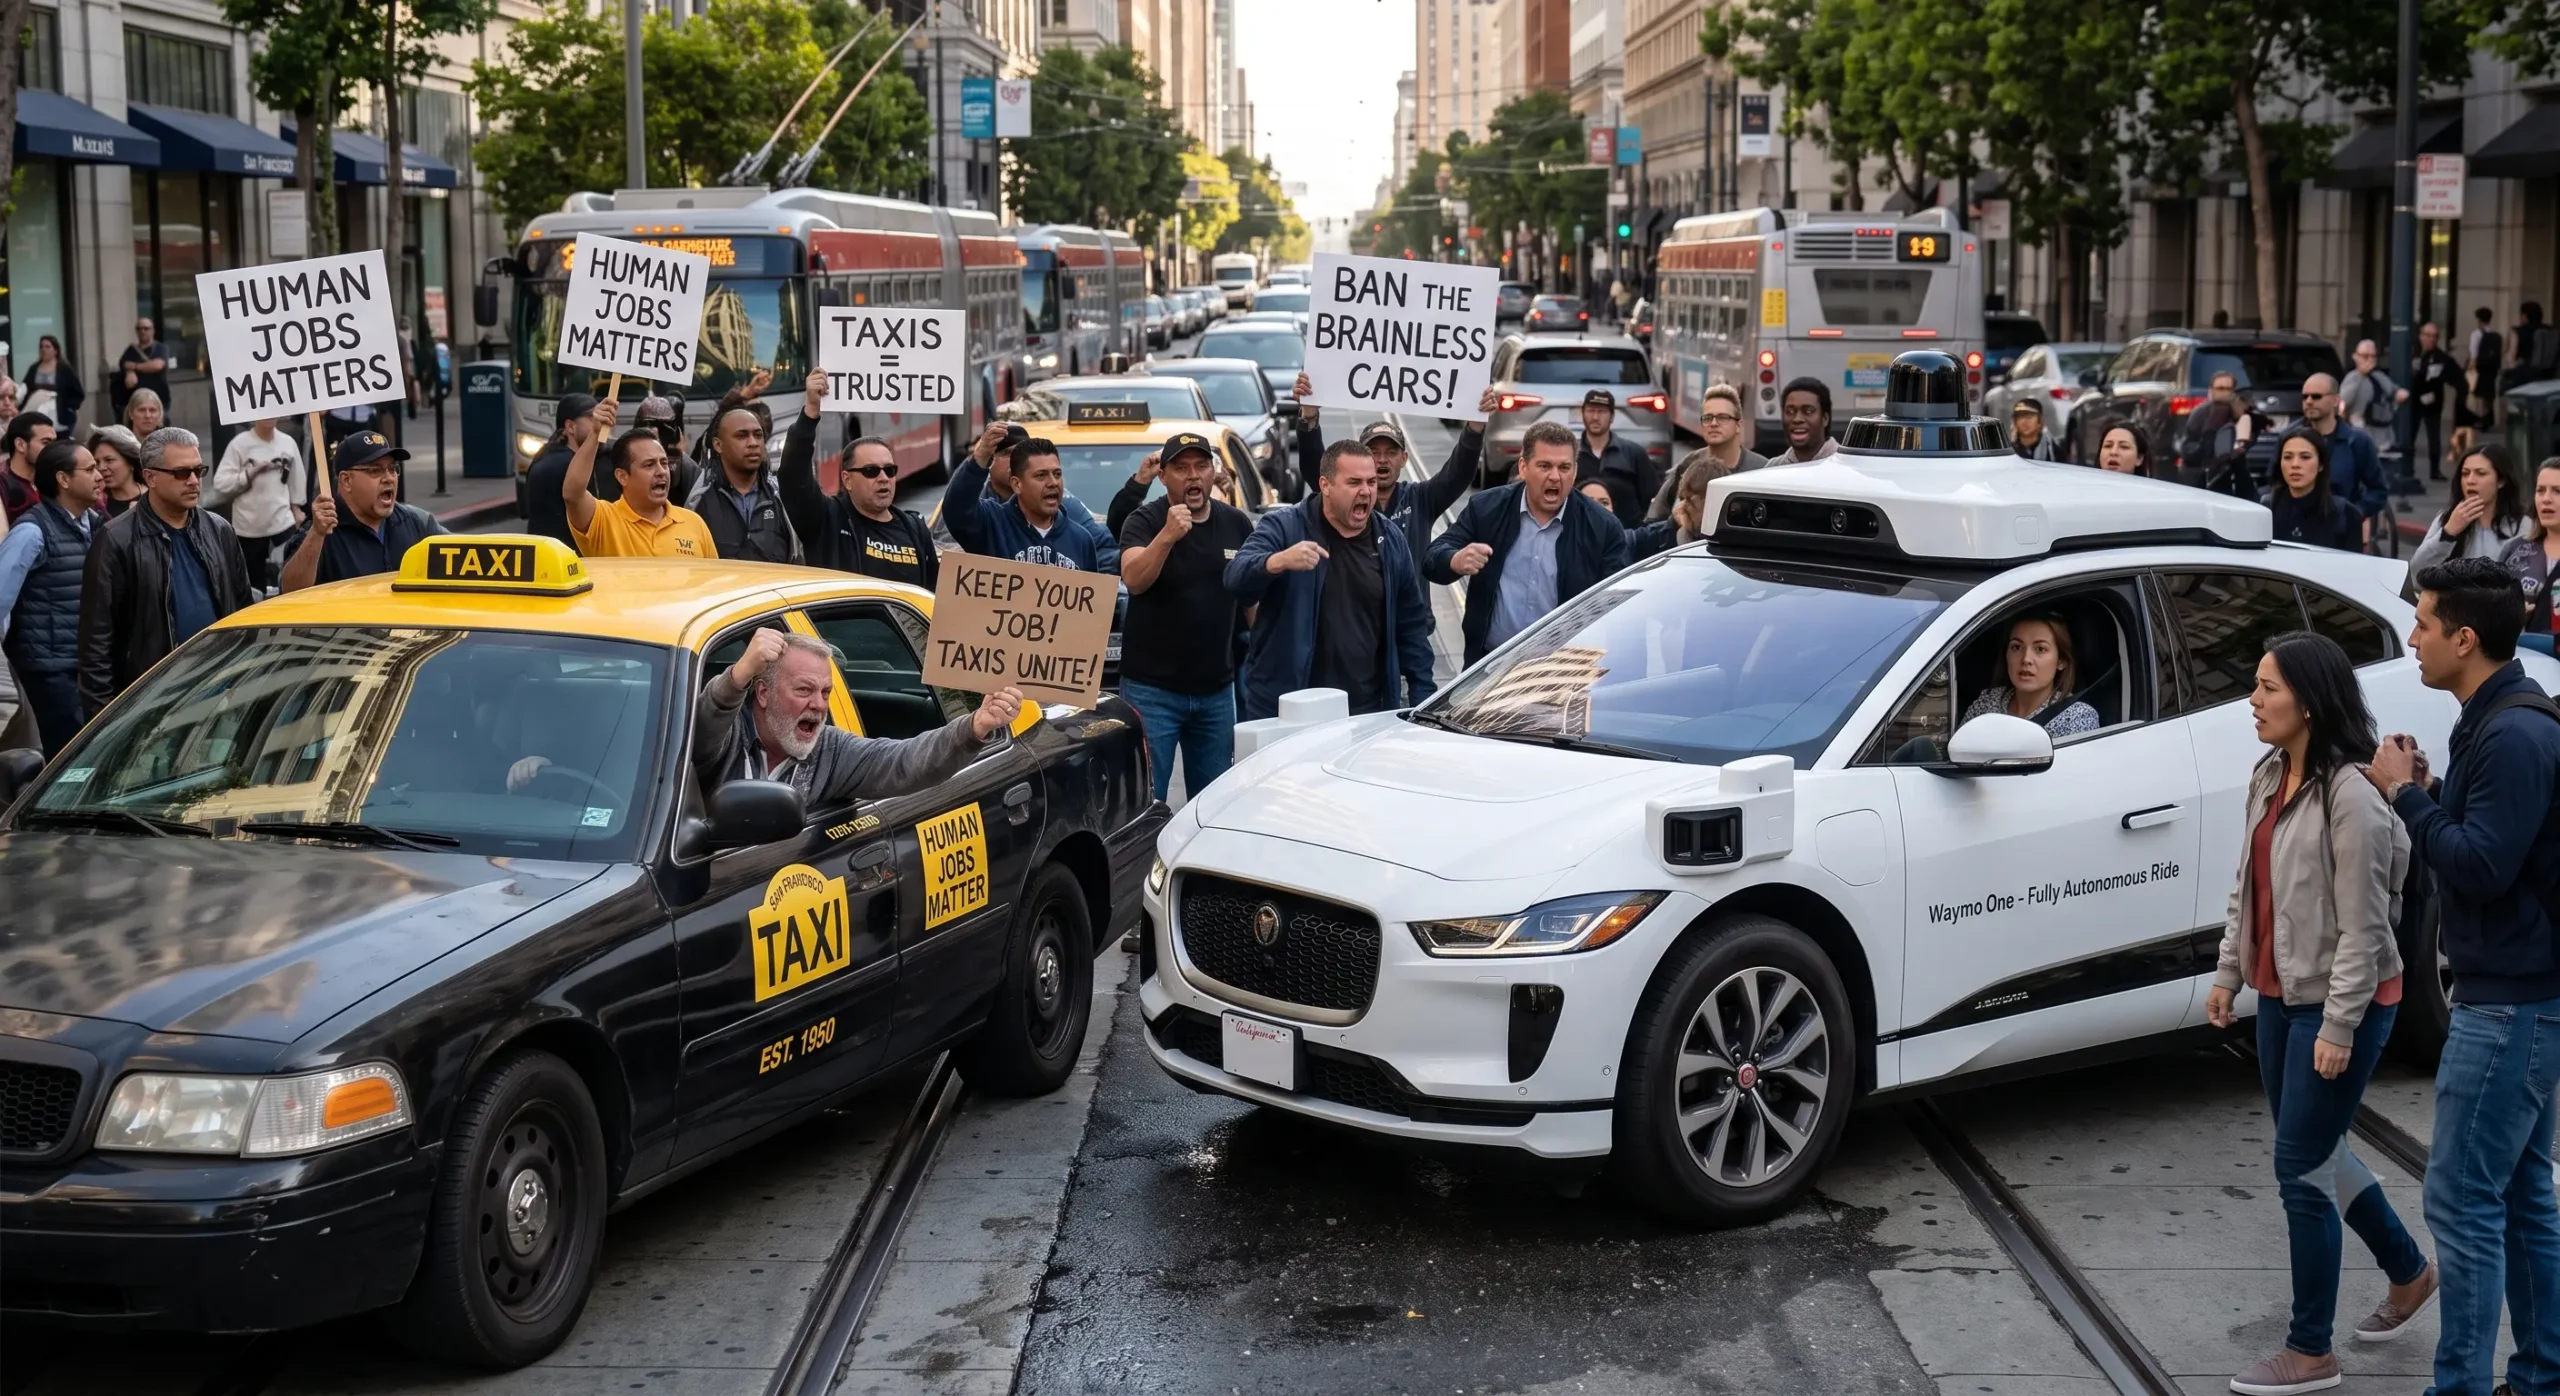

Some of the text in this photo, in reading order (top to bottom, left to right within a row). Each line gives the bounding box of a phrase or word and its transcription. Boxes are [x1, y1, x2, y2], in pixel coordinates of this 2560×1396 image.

[219, 264, 371, 319] HUMAN
[590, 247, 690, 294] HUMAN
[1334, 266, 1472, 312] BAN THE
[595, 289, 672, 329] JOBS
[831, 315, 942, 349] TAXIS
[251, 313, 360, 361] JOBS
[567, 323, 688, 372] MATTERS
[1315, 313, 1487, 363] BRAINLESS
[225, 354, 393, 412] MATTERS
[827, 372, 955, 402] TRUSTED
[1348, 363, 1459, 408] CARS!
[1081, 407, 1126, 418] TAXI
[440, 547, 522, 577] TAXI
[955, 565, 1095, 613] KEEP YOUR
[986, 609, 1060, 643] JOB!
[938, 640, 1099, 687] TAXIS UNITE!
[923, 811, 980, 854] HUMAN
[939, 846, 975, 884] JOBS
[929, 874, 985, 922] MATTER
[1929, 901, 1983, 925] Waymo
[1986, 893, 2015, 914] One
[2028, 884, 2061, 907] Fully
[2063, 866, 2148, 899] Autonomous
[2151, 860, 2180, 884] Ride
[757, 898, 844, 988] TAXI
[759, 1017, 836, 1075] EST. 1950
